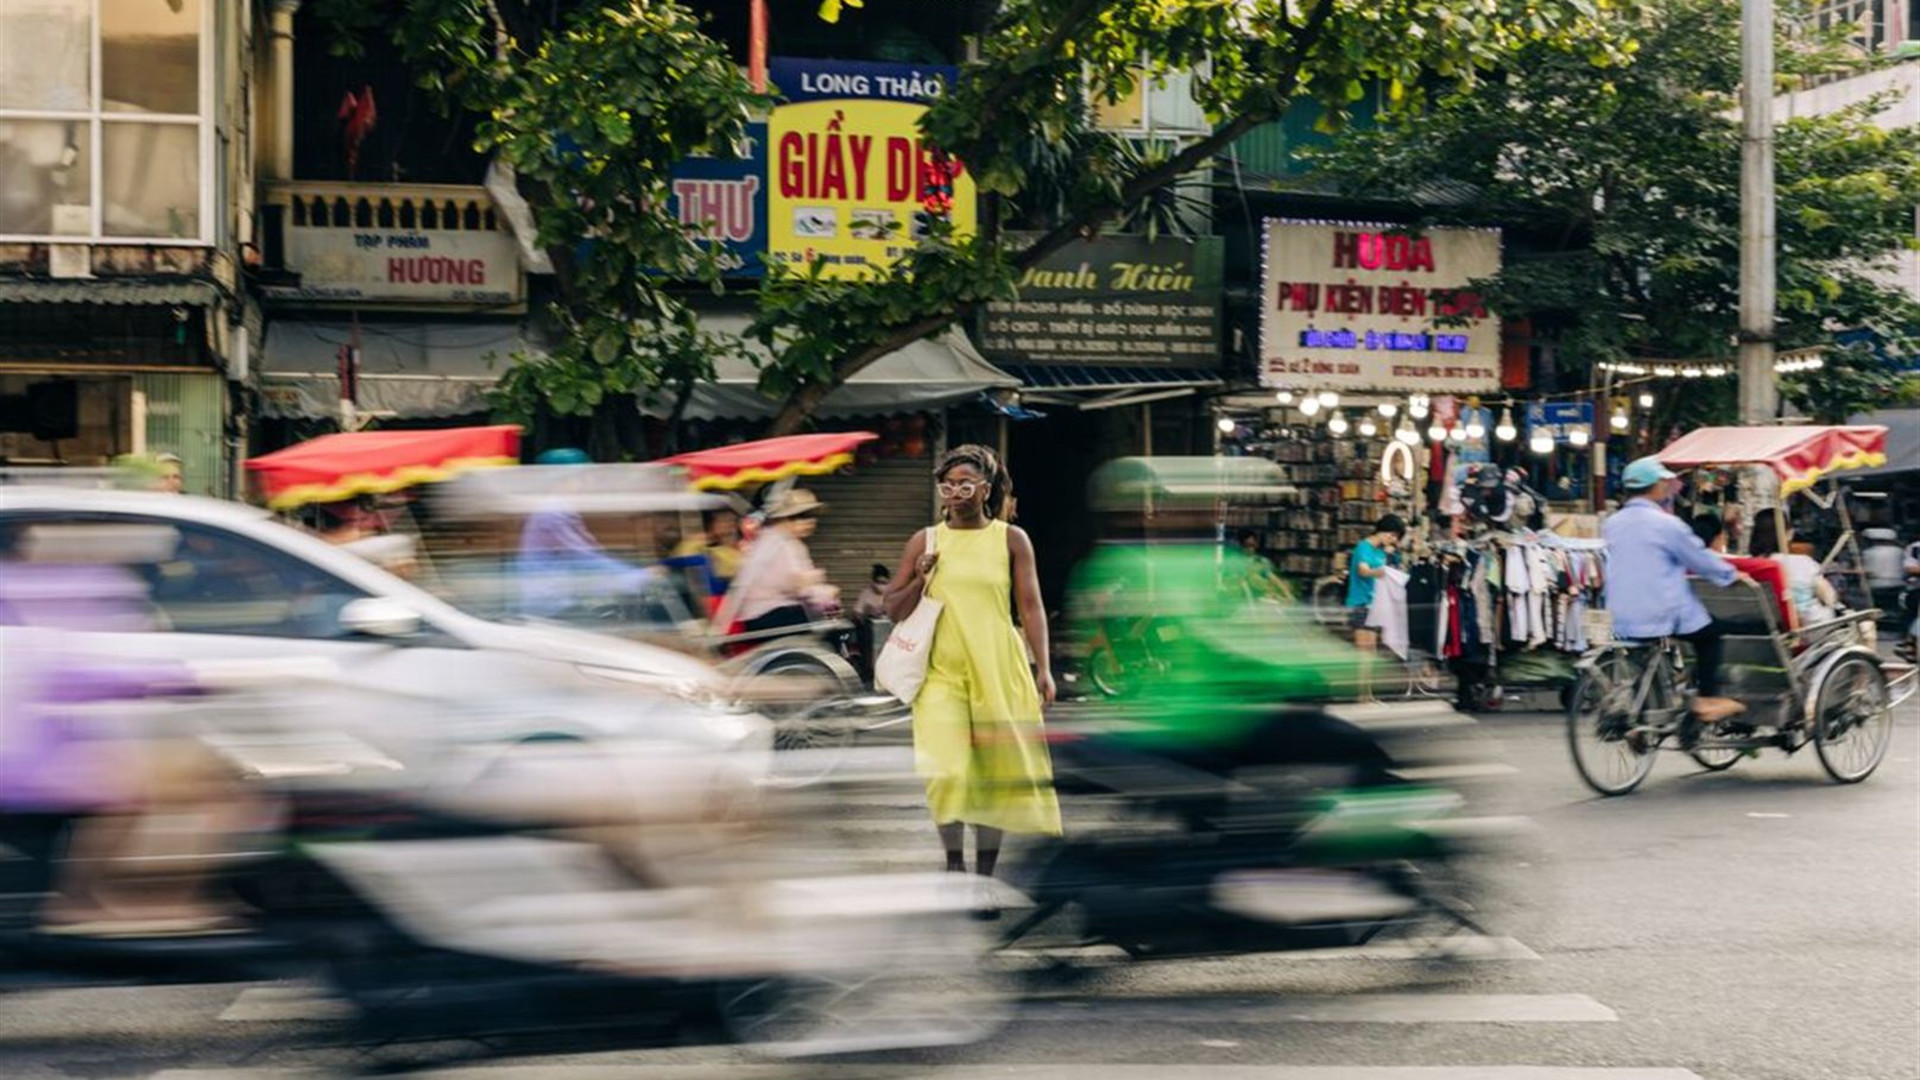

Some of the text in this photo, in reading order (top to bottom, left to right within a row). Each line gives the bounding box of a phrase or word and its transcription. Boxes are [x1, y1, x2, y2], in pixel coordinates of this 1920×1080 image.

[801, 72, 870, 95] LONG
[673, 175, 760, 242] THƯ
[1333, 232, 1436, 272] HUDA
[387, 255, 485, 285] HƯƠNG
